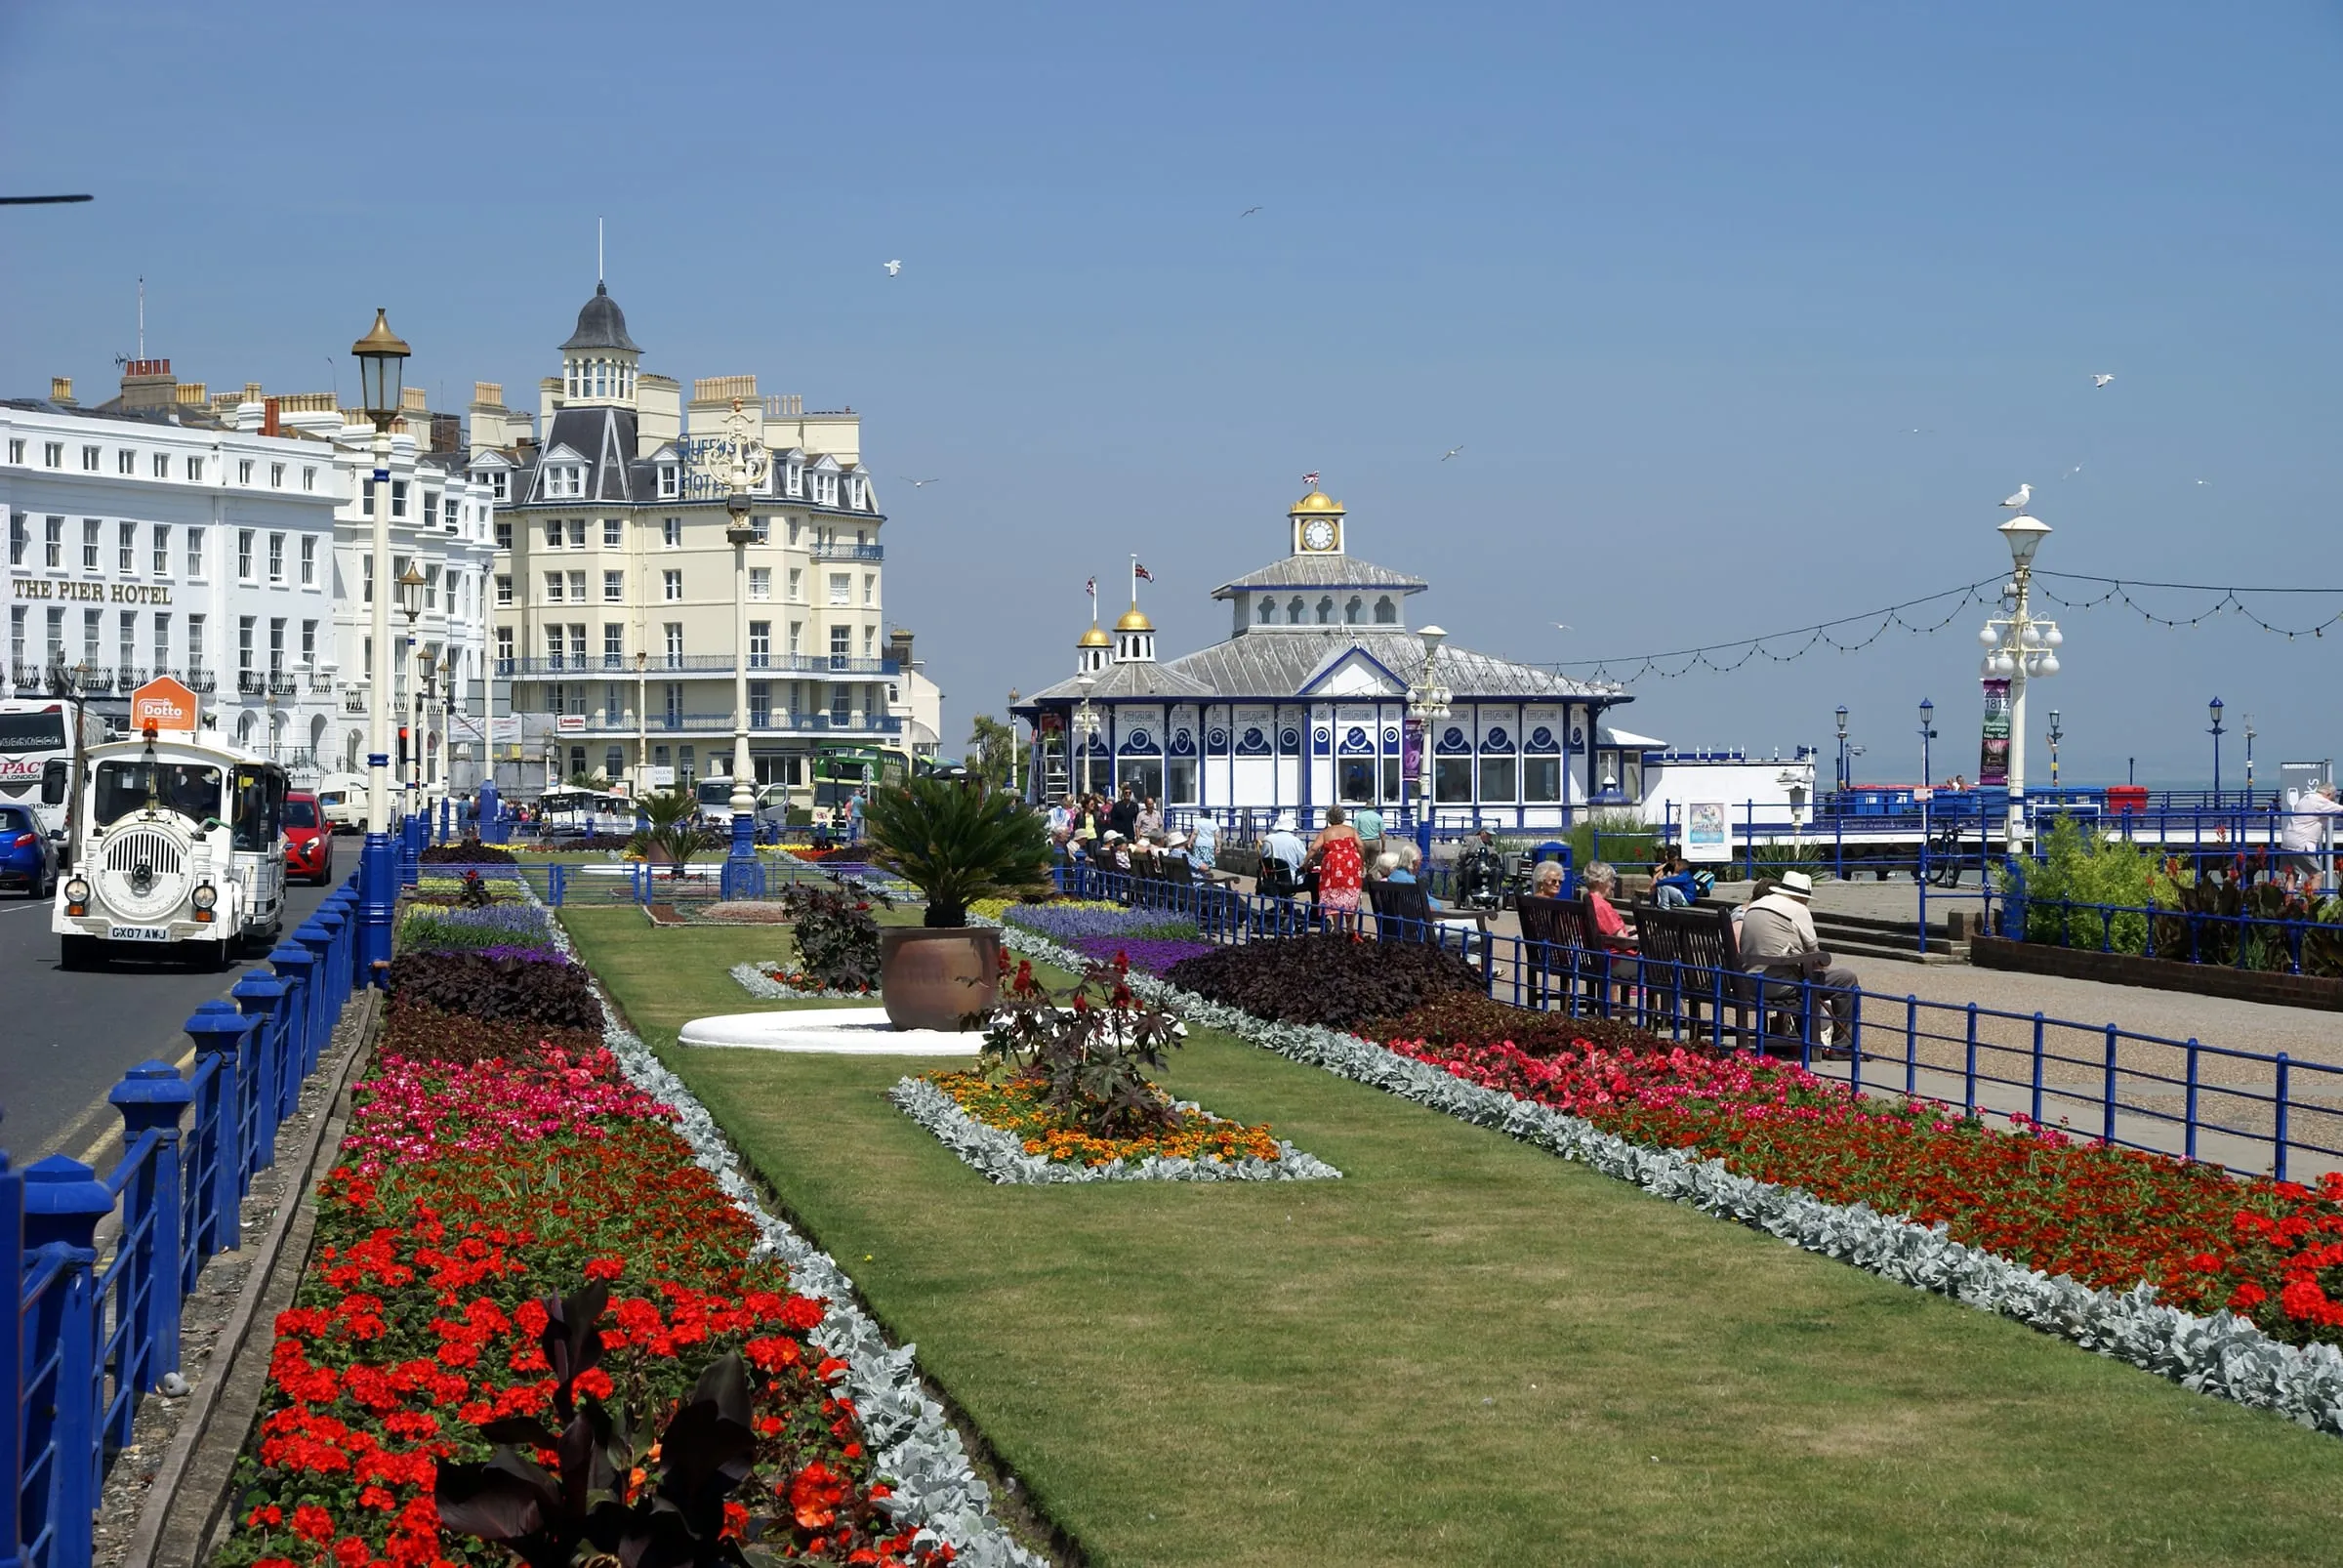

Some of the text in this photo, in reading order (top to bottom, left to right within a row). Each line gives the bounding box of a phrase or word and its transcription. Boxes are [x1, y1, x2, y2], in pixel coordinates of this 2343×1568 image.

[13, 579, 173, 605] THE PIER HOTEL
[144, 704, 182, 716] Dotto
[1985, 698, 2010, 710] 1812
[112, 928, 166, 939] GX07 AWJ
